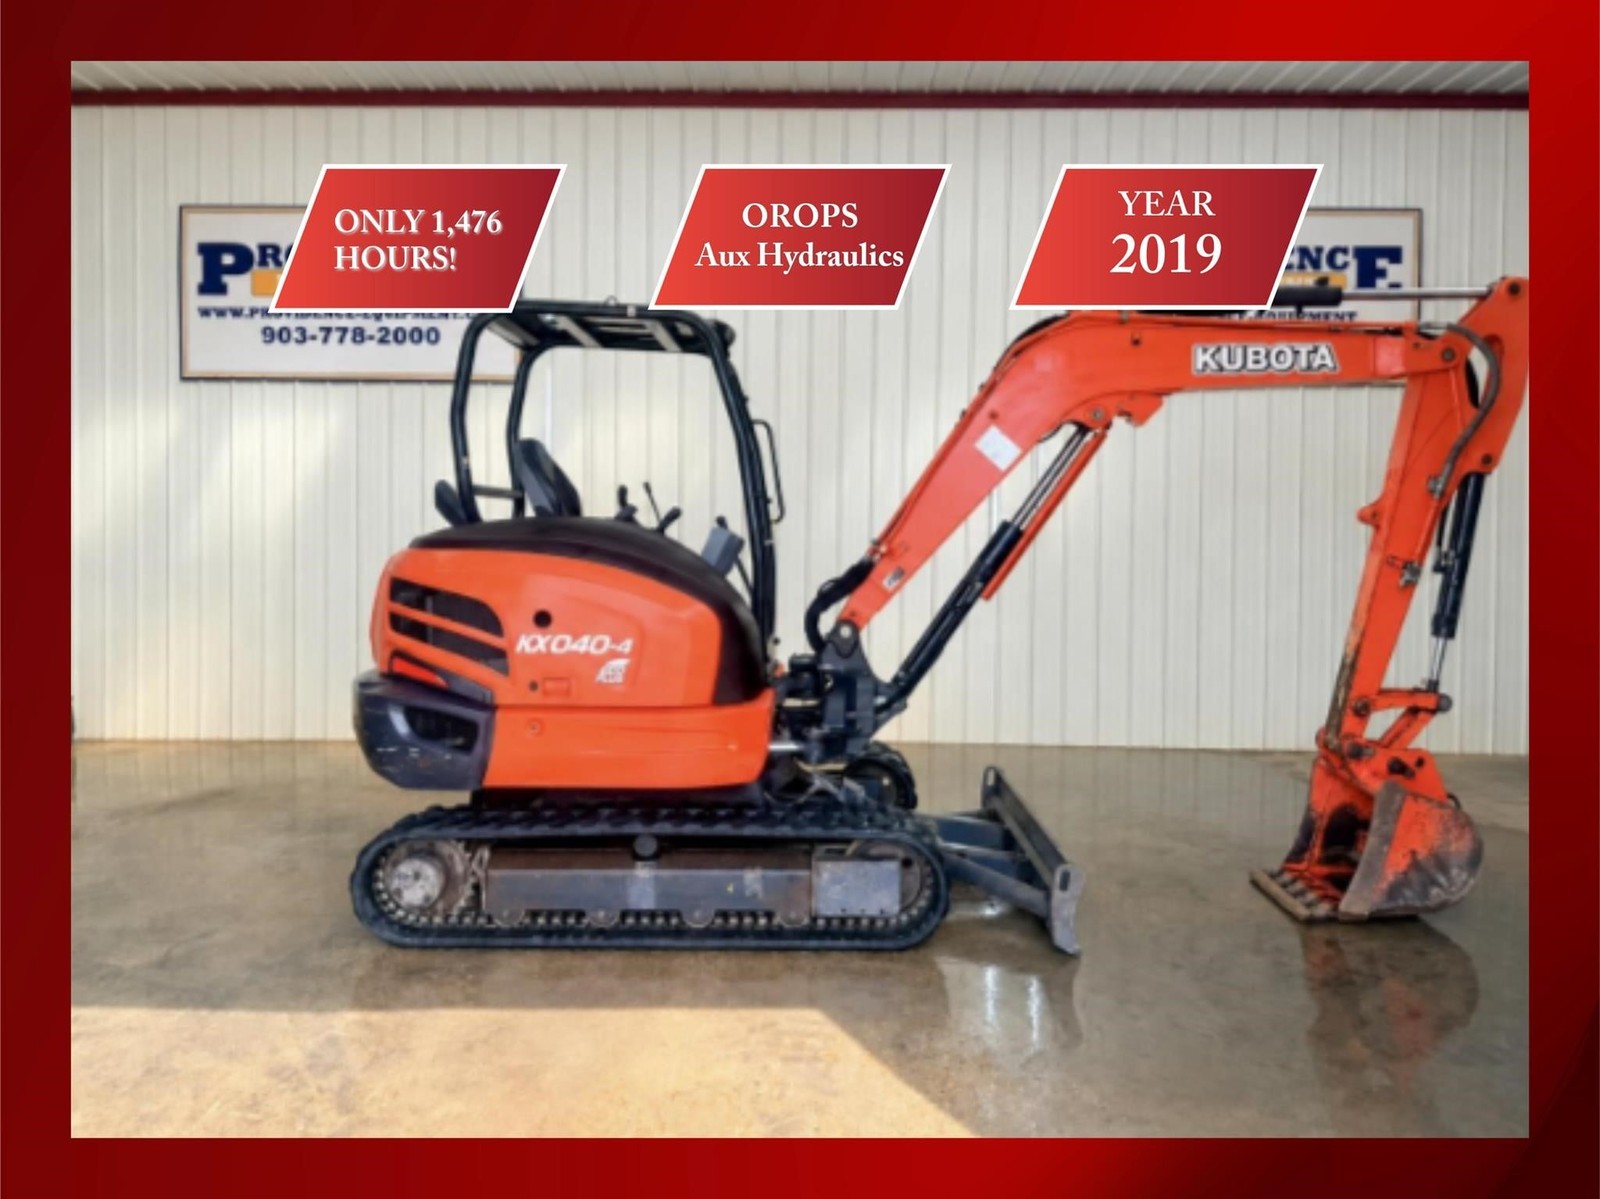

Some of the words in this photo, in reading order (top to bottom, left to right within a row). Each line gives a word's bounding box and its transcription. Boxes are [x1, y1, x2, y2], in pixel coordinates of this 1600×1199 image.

[261, 325, 441, 346] 903-778-2000
[1193, 343, 1337, 373] KUBOTA
[515, 634, 634, 655] KX040-4
